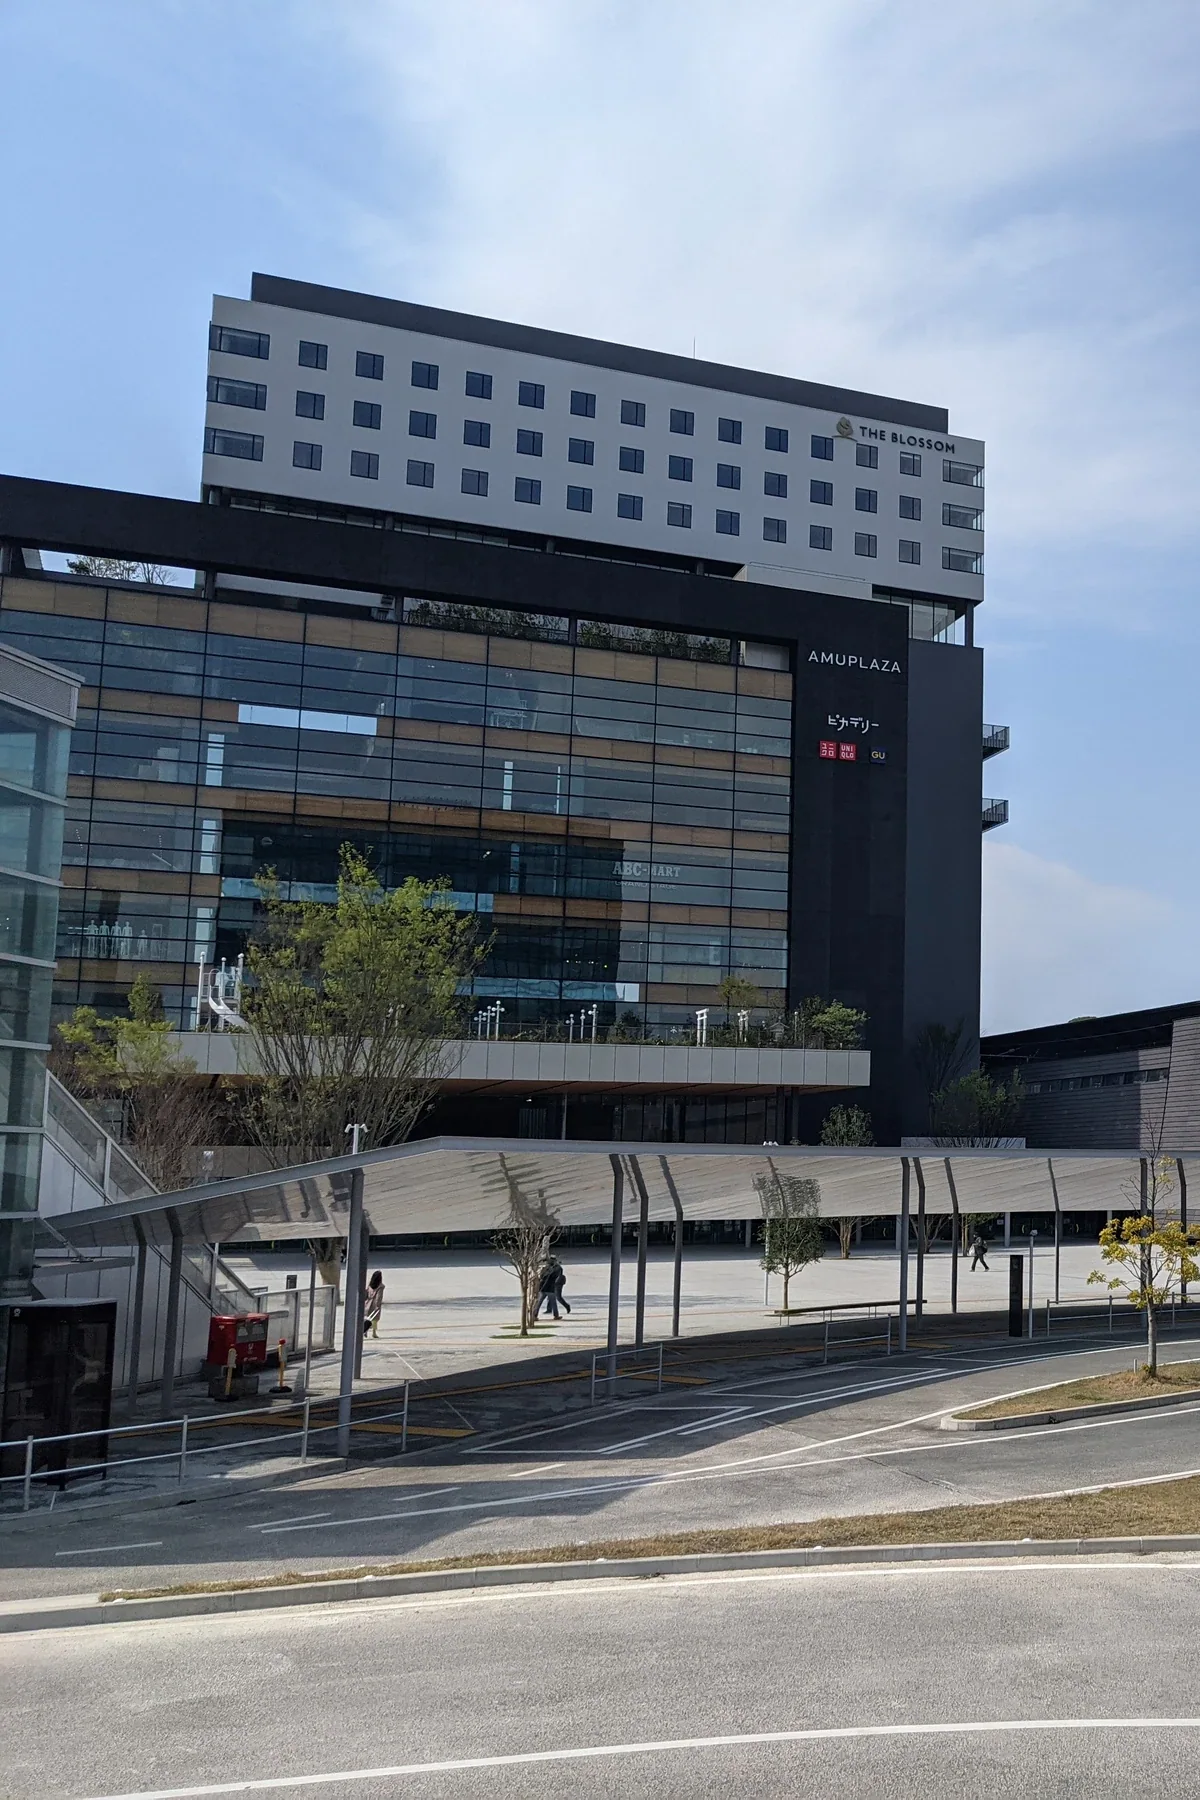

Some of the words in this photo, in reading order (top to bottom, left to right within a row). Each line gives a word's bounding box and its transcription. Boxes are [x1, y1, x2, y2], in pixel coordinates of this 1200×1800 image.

[859, 426, 886, 441] THE
[891, 432, 956, 454] BLOSSOM
[808, 650, 901, 673] AMUPLAZA
[827, 714, 880, 734] ピカデリー
[871, 750, 886, 760] GU
